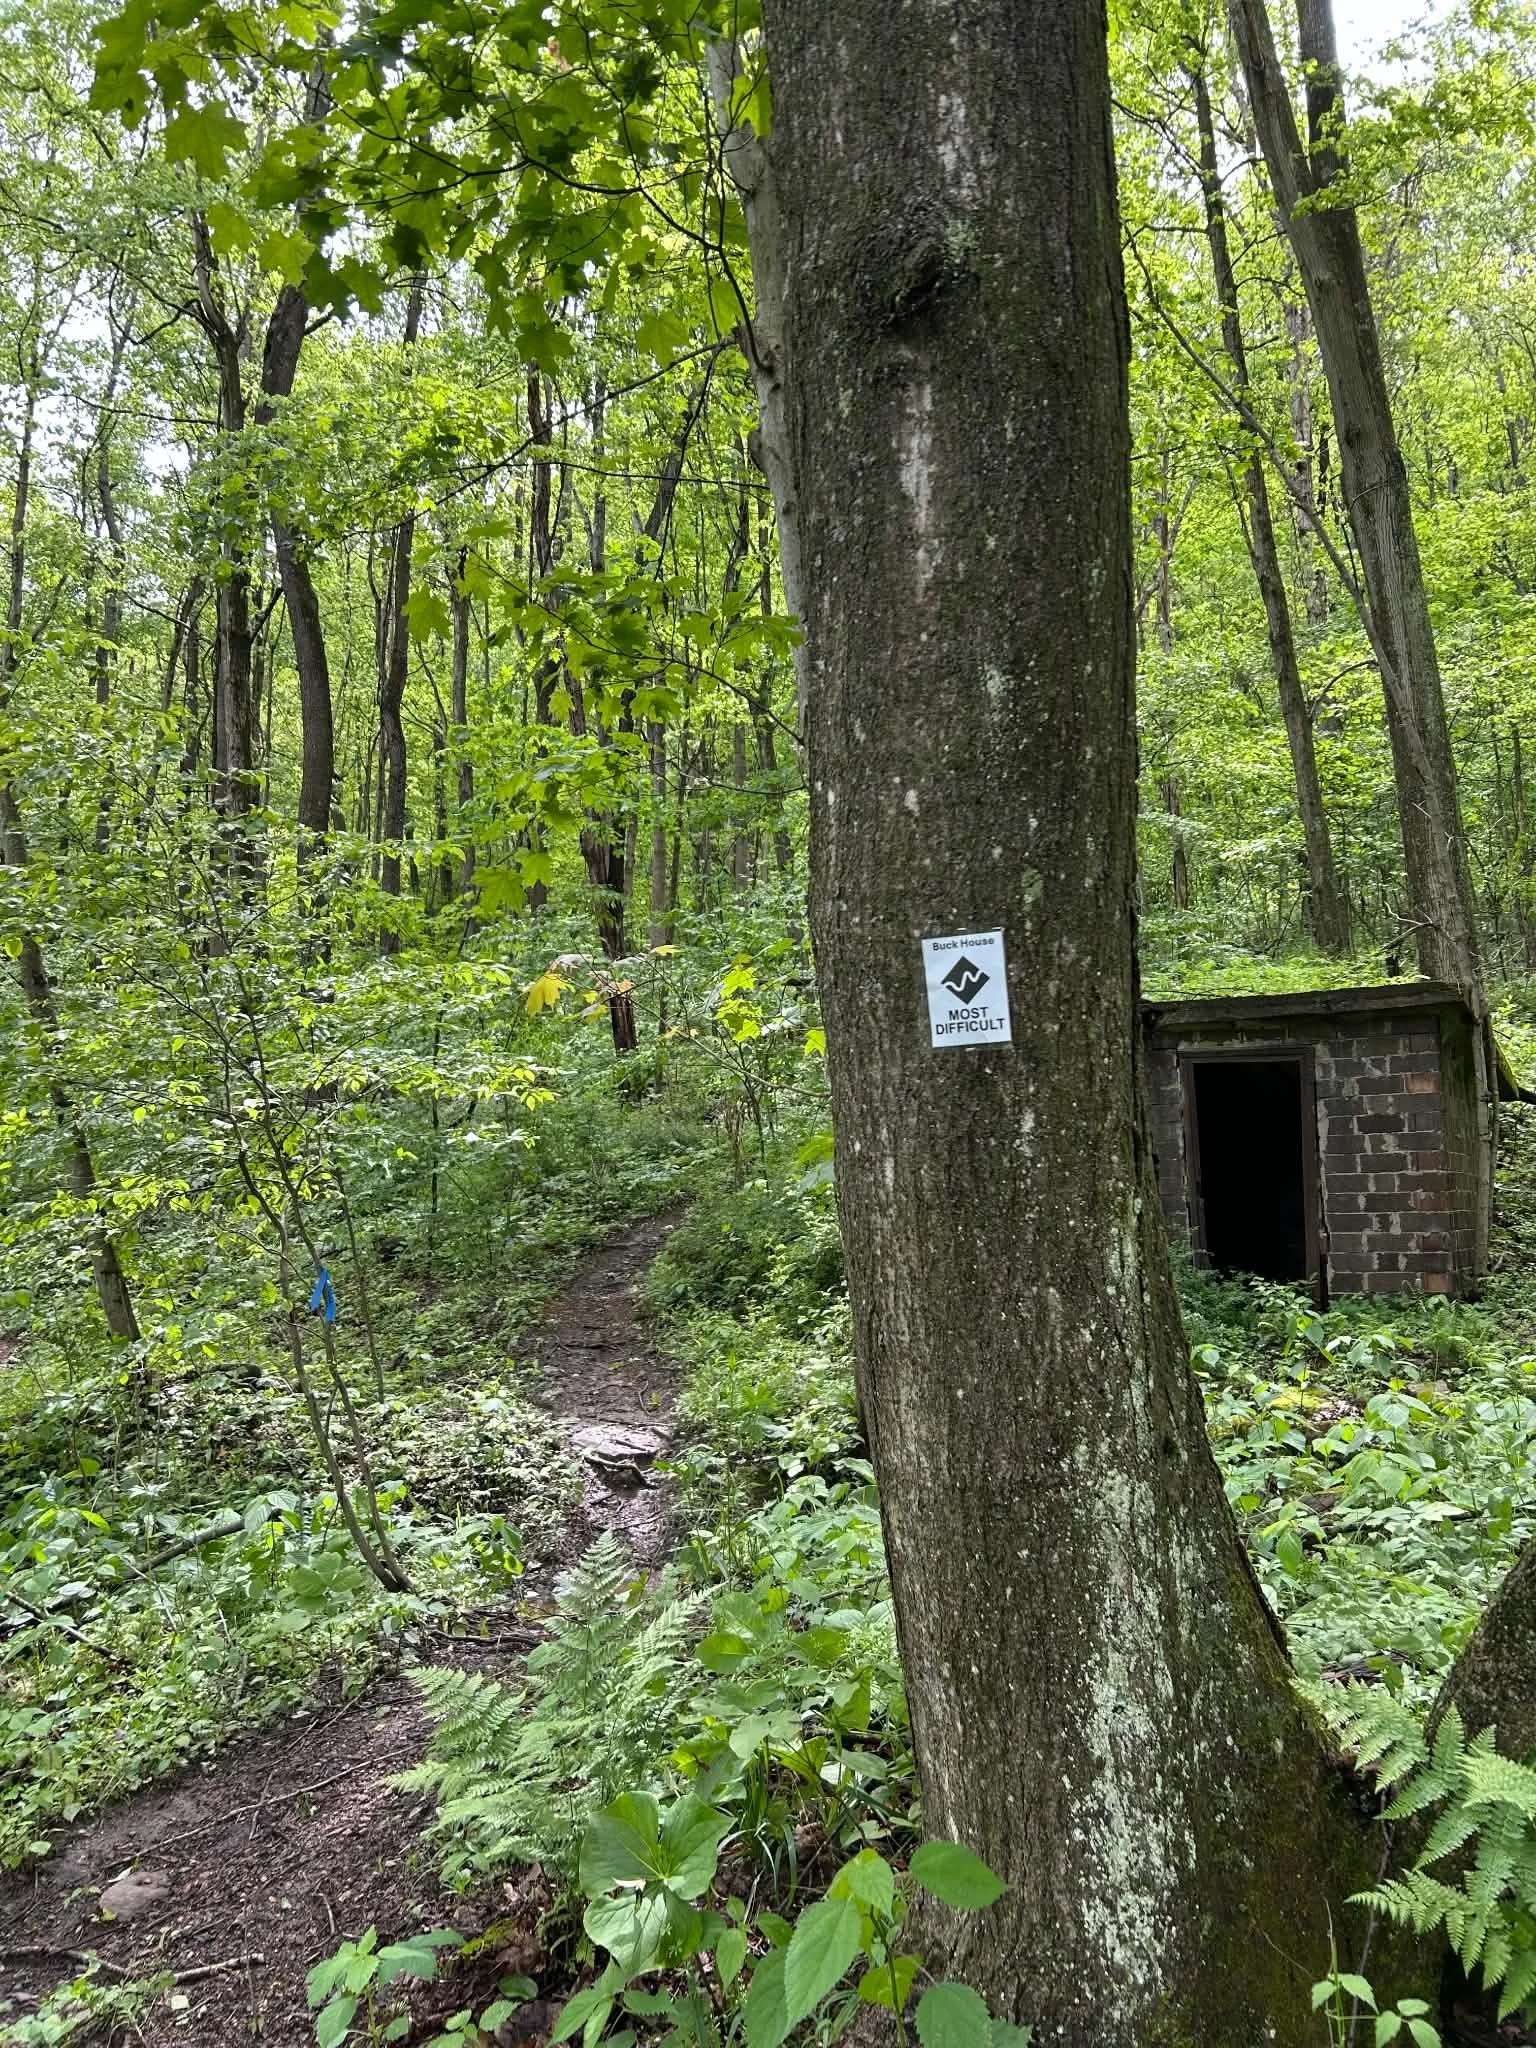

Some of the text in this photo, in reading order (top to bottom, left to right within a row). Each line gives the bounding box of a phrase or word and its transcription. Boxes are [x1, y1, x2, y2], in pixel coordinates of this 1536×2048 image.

[932, 937, 994, 951] Buck House
[949, 1006, 989, 1020] MOST
[936, 1018, 1005, 1034] DIFFICULT
